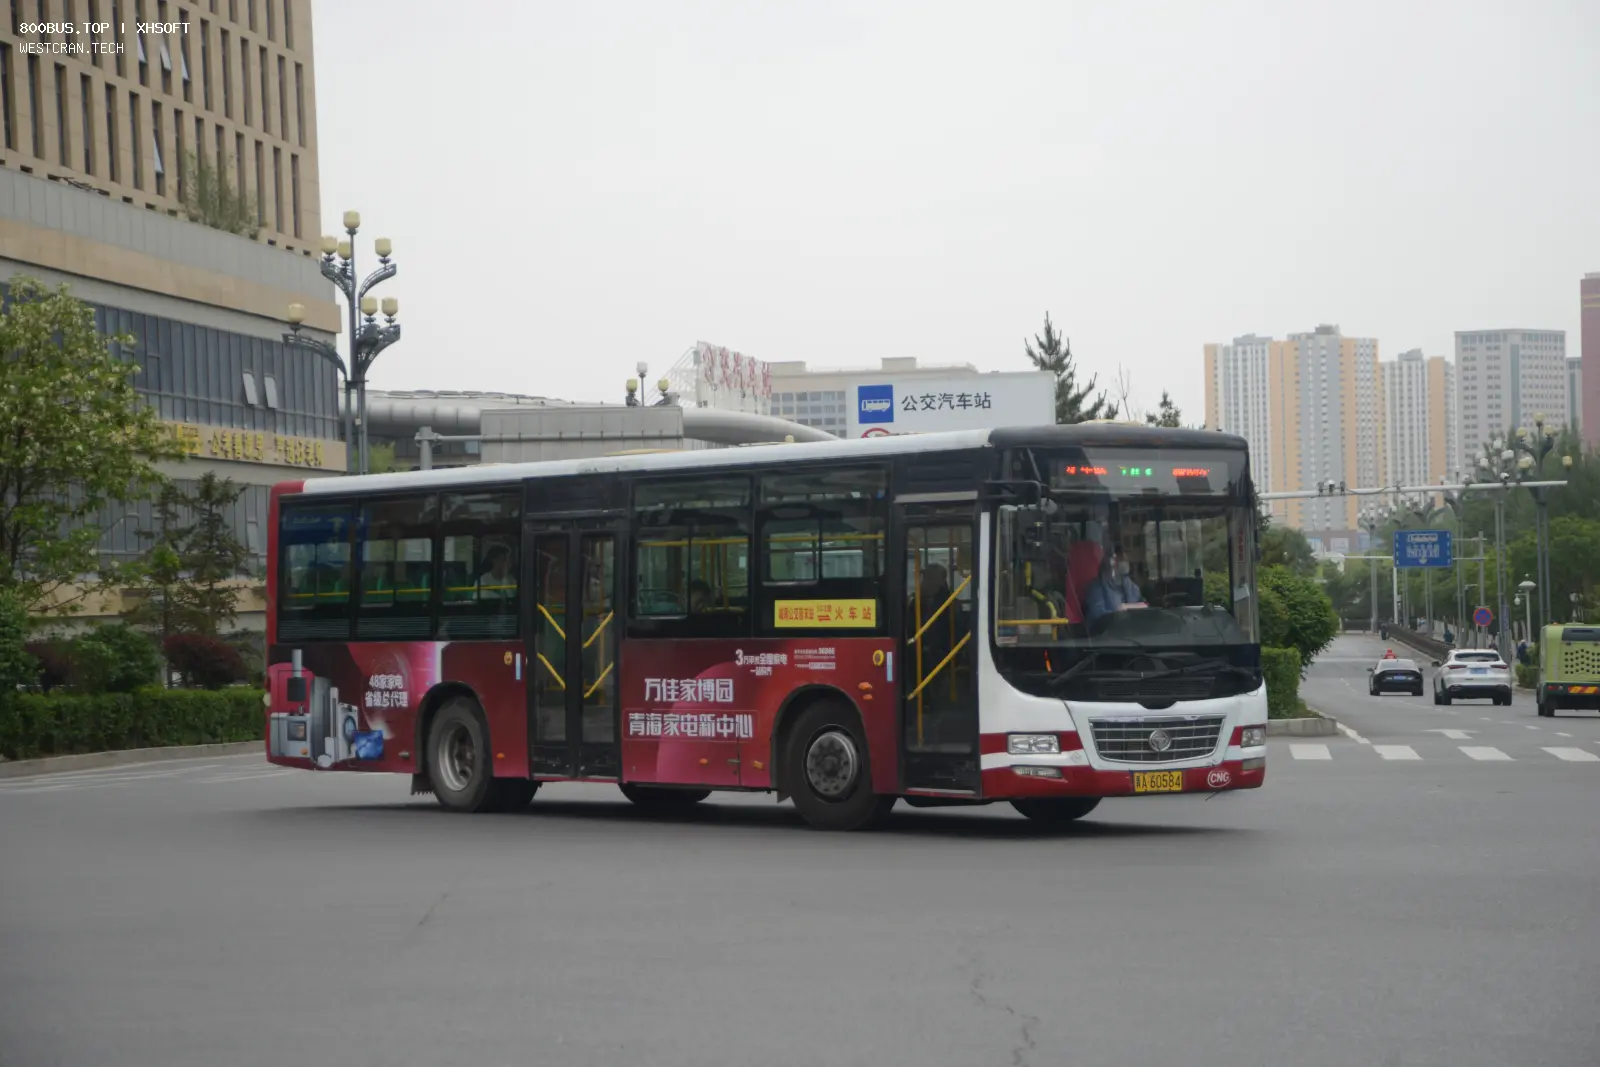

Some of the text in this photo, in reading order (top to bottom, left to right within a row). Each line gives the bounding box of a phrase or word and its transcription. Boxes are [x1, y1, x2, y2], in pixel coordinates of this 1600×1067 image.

[901, 391, 992, 412] 公交汽车站
[365, 690, 409, 708] 省级总代理
[644, 678, 734, 703] 万佳家博园
[628, 712, 753, 738] 青海家电新中心
[1210, 771, 1230, 783] CNG
